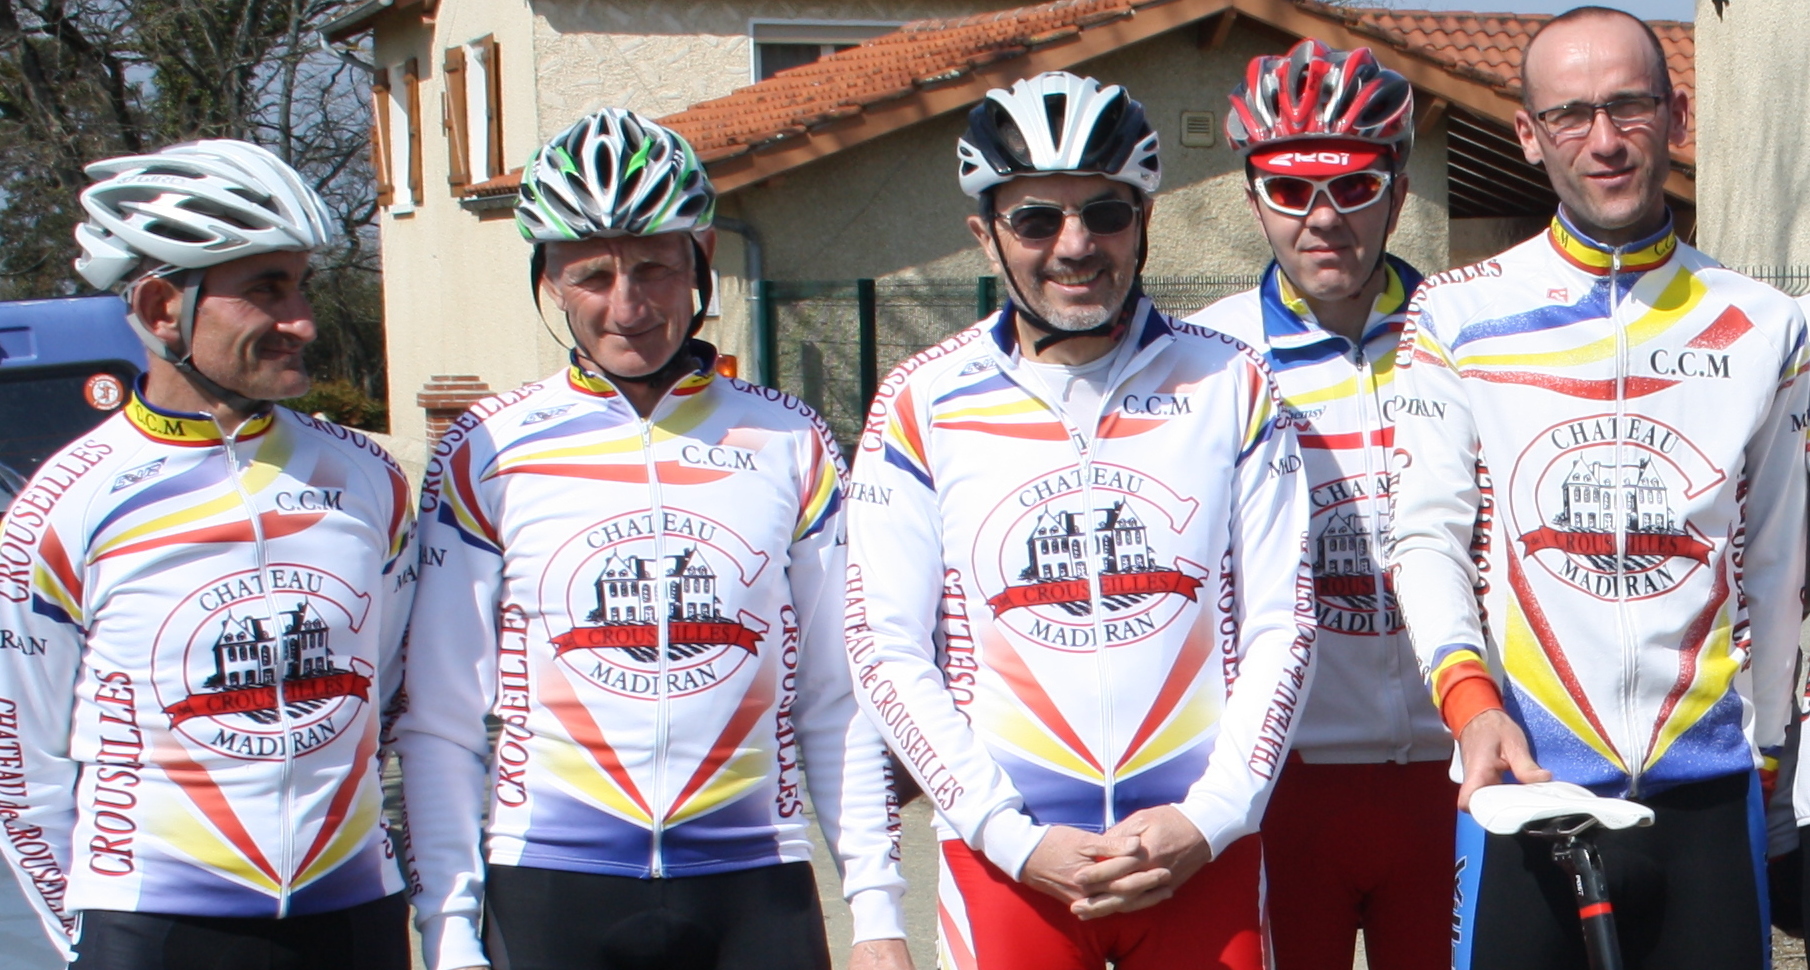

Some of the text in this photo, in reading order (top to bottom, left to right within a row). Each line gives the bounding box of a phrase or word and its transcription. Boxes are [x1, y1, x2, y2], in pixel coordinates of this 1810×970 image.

[1649, 347, 1732, 379] C.C.M
[1123, 395, 1193, 416] C.C.M
[1551, 416, 1679, 451] CHATEAU
[681, 444, 759, 472] C.C.M
[275, 490, 343, 512] C.C.M
[1018, 465, 1144, 509] CHATEAU
[0, 438, 113, 604] CROUSEILLES
[586, 511, 719, 550] CHATEAU
[199, 568, 324, 613] CHATEAU
[870, 679, 965, 812] CROUSEILLES
